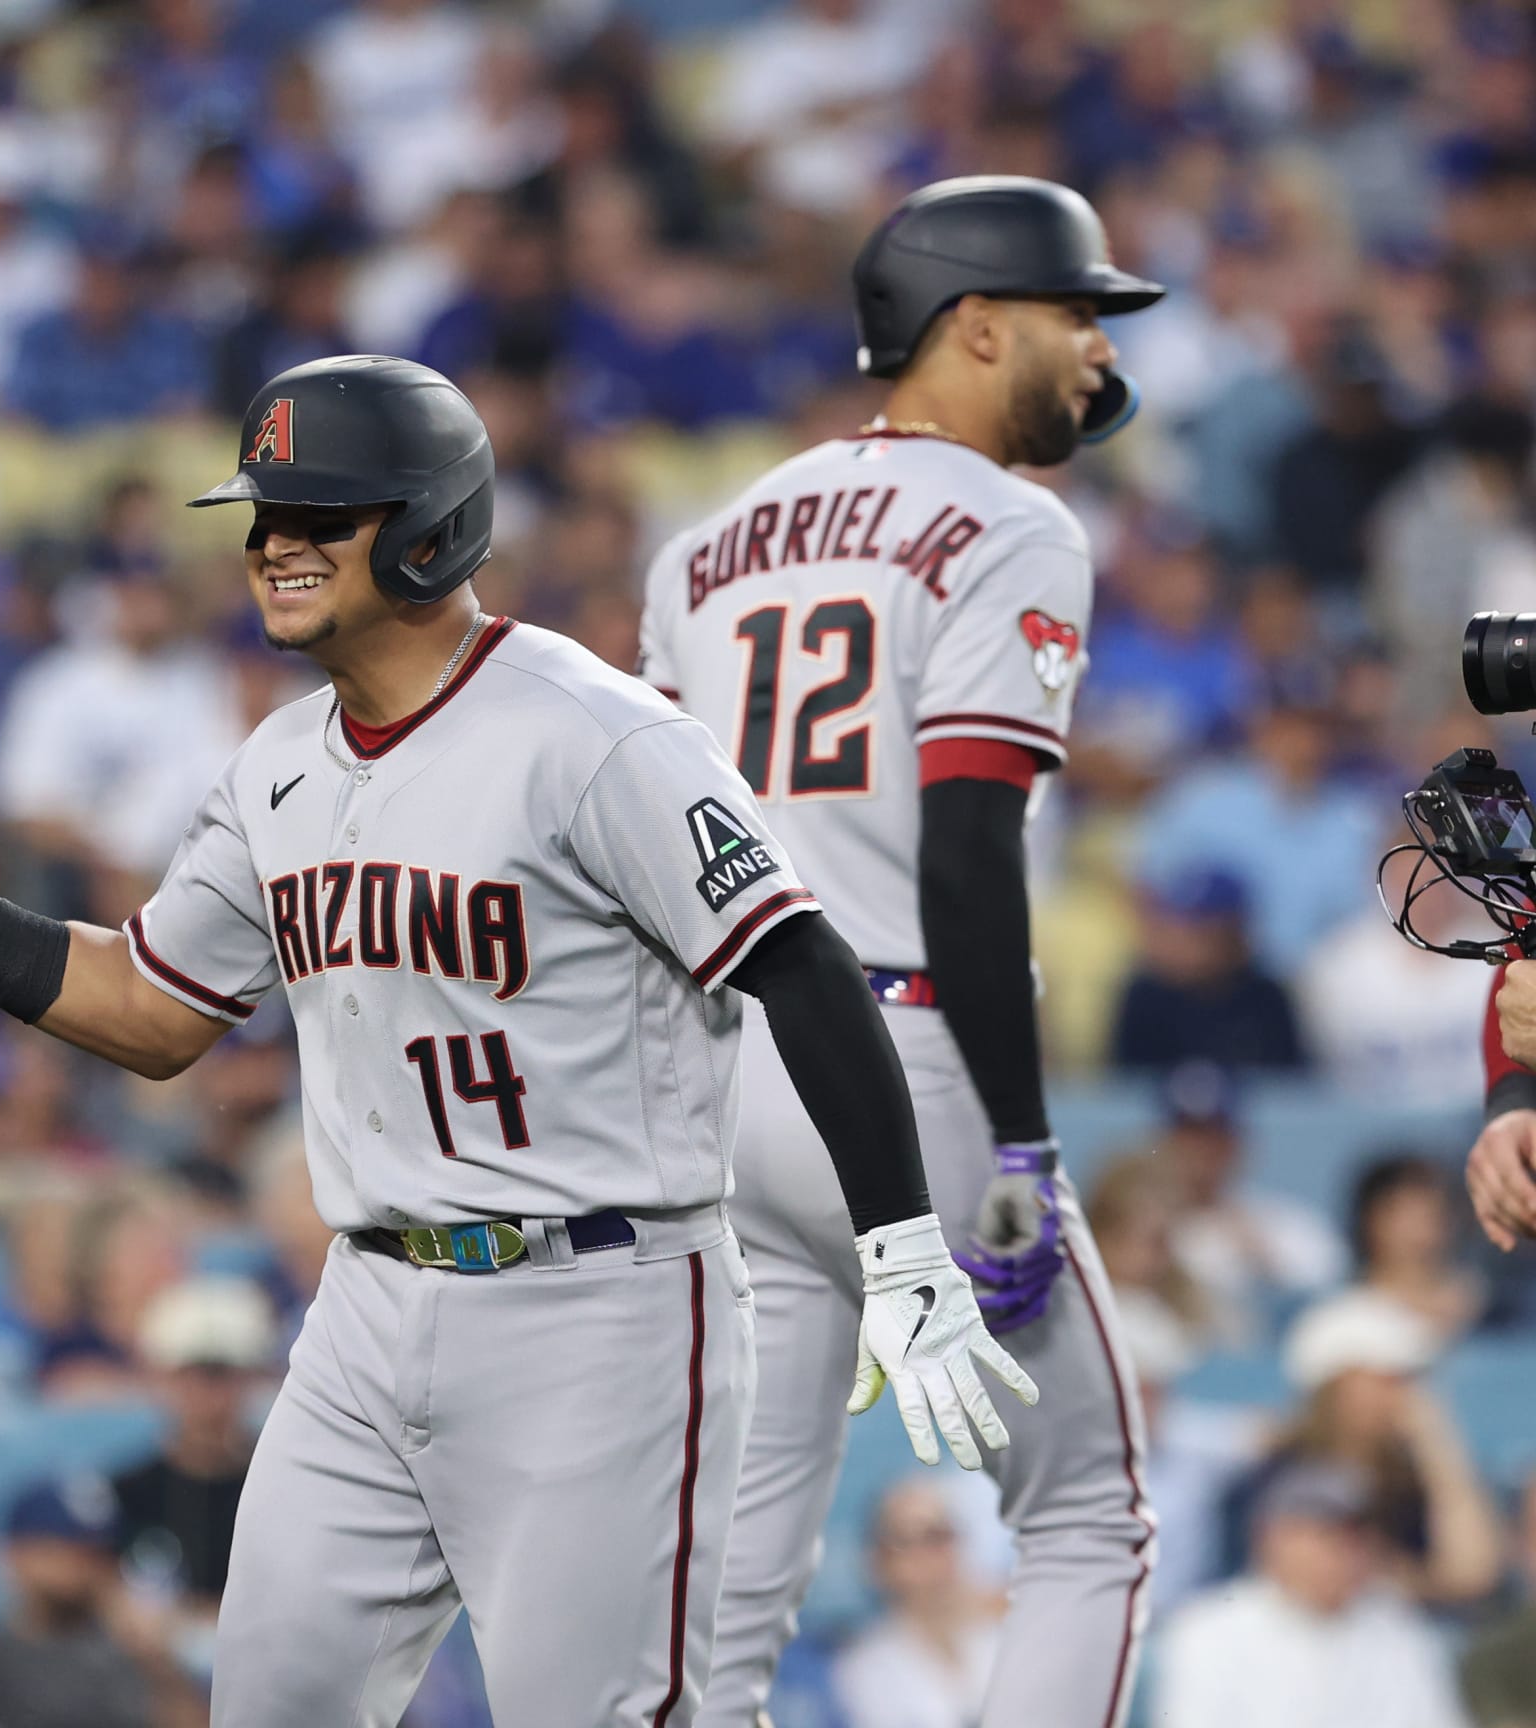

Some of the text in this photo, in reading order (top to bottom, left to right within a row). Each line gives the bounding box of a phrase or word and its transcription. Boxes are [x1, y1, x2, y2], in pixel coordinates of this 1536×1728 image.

[243, 398, 293, 463] A
[688, 486, 897, 613] GURRIEL
[733, 596, 874, 796] 12
[260, 858, 532, 1003] RIZONA
[404, 1029, 532, 1157] 14
